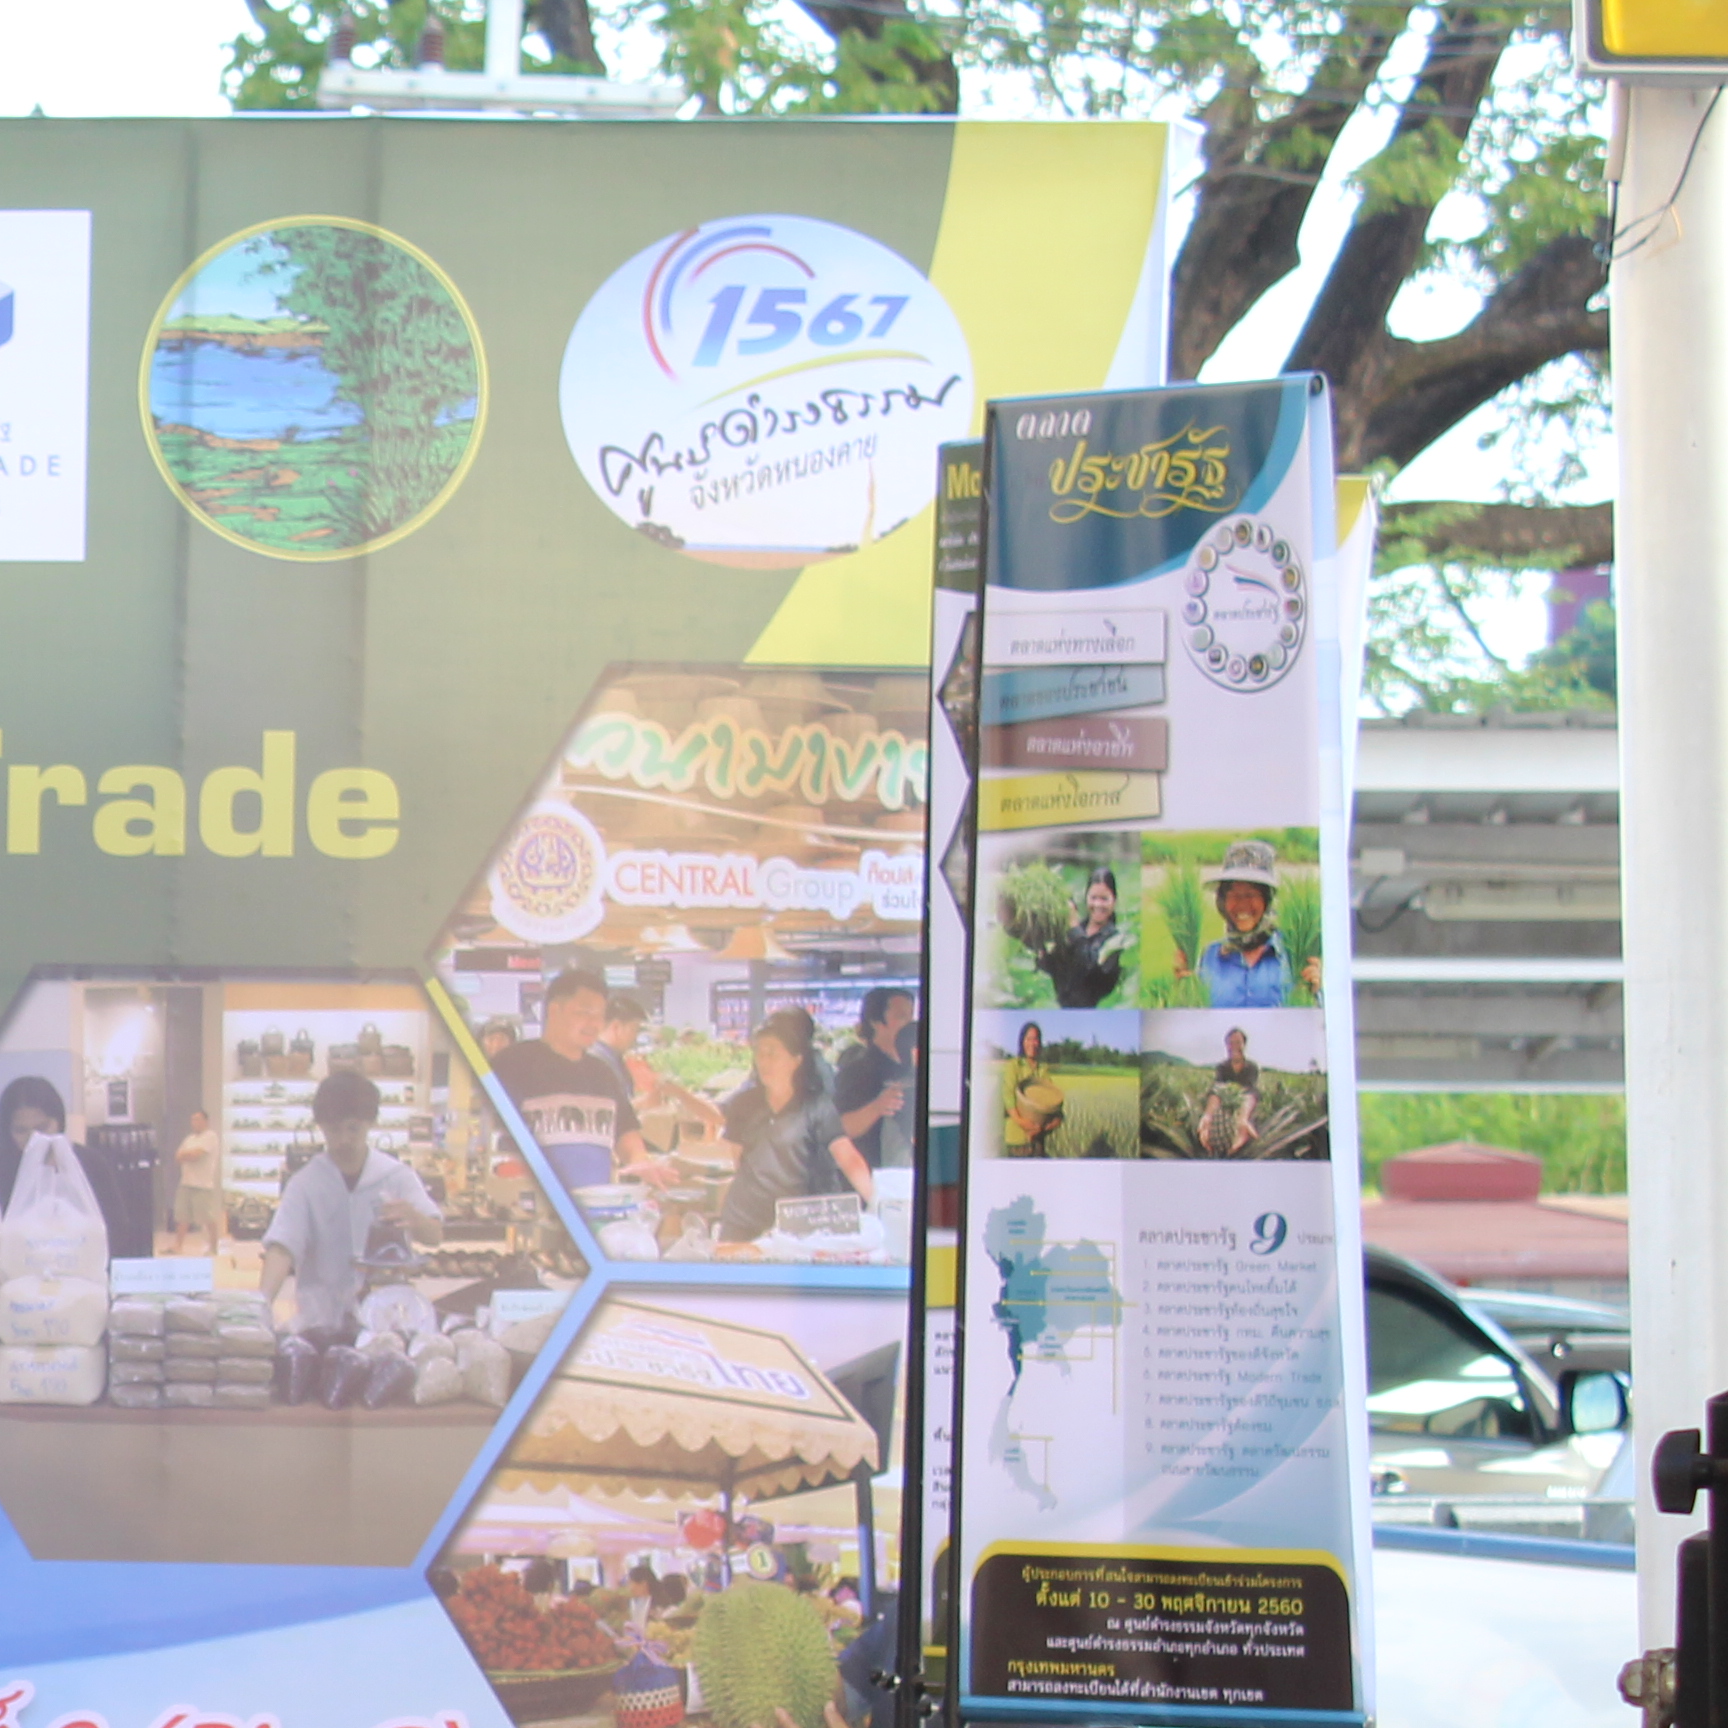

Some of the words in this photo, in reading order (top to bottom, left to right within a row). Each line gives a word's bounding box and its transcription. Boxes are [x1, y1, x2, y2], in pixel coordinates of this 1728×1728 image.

[692, 285, 911, 366] 1567
[1017, 410, 1091, 440] ตลาด
[690, 431, 877, 510] จังหวัดหนองคาย
[1049, 418, 1239, 524] ประชารัฐ
[614, 863, 753, 897] CENTRAL
[767, 871, 854, 905] Group
[1249, 1211, 1288, 1255] 9
[1036, 1582, 1081, 1608] ตั้งแต่
[1088, 1592, 1110, 1609] 10
[1133, 1594, 1155, 1611] 30
[1258, 1598, 1304, 1616] 2560
